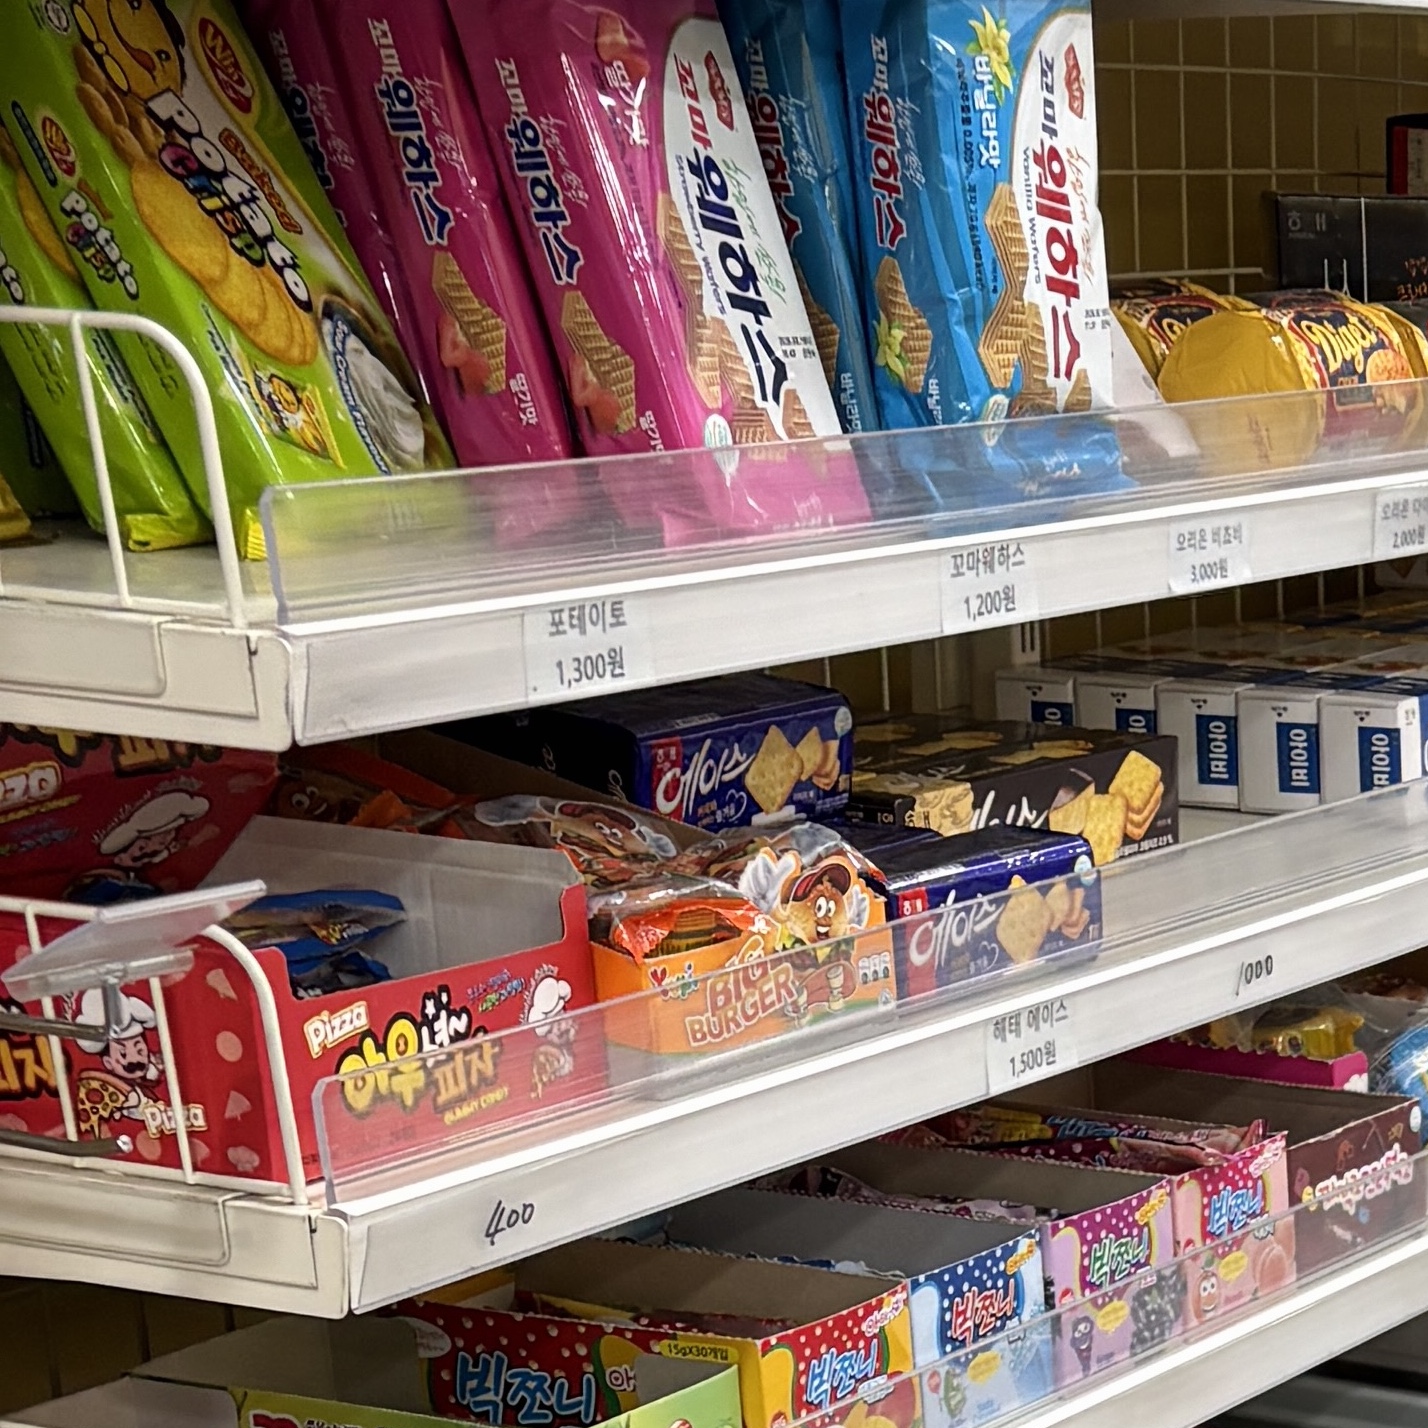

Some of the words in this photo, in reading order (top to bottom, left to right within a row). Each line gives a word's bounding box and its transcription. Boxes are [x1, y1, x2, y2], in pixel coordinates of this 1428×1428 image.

[367, 18, 402, 77] 꼬마
[869, 34, 889, 91] 꼬마
[495, 57, 528, 115] 꼬마
[674, 53, 713, 149] 꼬마
[1037, 51, 1061, 141] 꼬마
[374, 76, 455, 246] 웨하스
[864, 90, 907, 249] 웨하스
[504, 114, 584, 286] 웨하스
[684, 145, 789, 408] 웨하스
[1032, 140, 1082, 382] 웨하스
[950, 544, 1026, 579] 꼬마웨하스
[1174, 523, 1208, 551] 오리온
[1189, 561, 1230, 583] 3,000원
[547, 601, 629, 639] 포테이토
[963, 584, 1017, 620] 1,200원
[554, 648, 627, 687] 1,300원
[656, 737, 755, 819] 에이스
[1209, 720, 1229, 780] 아이비
[1290, 729, 1311, 787] 아이비
[909, 885, 1005, 967] 에이스
[704, 934, 781, 1012] BIG
[1236, 955, 1275, 996] 1000
[306, 1007, 367, 1055] Pizza
[686, 962, 795, 1049] BURGER
[992, 1012, 1023, 1043] 해태
[1026, 1000, 1070, 1034] 에이스
[432, 1038, 500, 1106] 피자
[1007, 1041, 1059, 1078] 1,500원
[484, 1199, 536, 1245] 400
